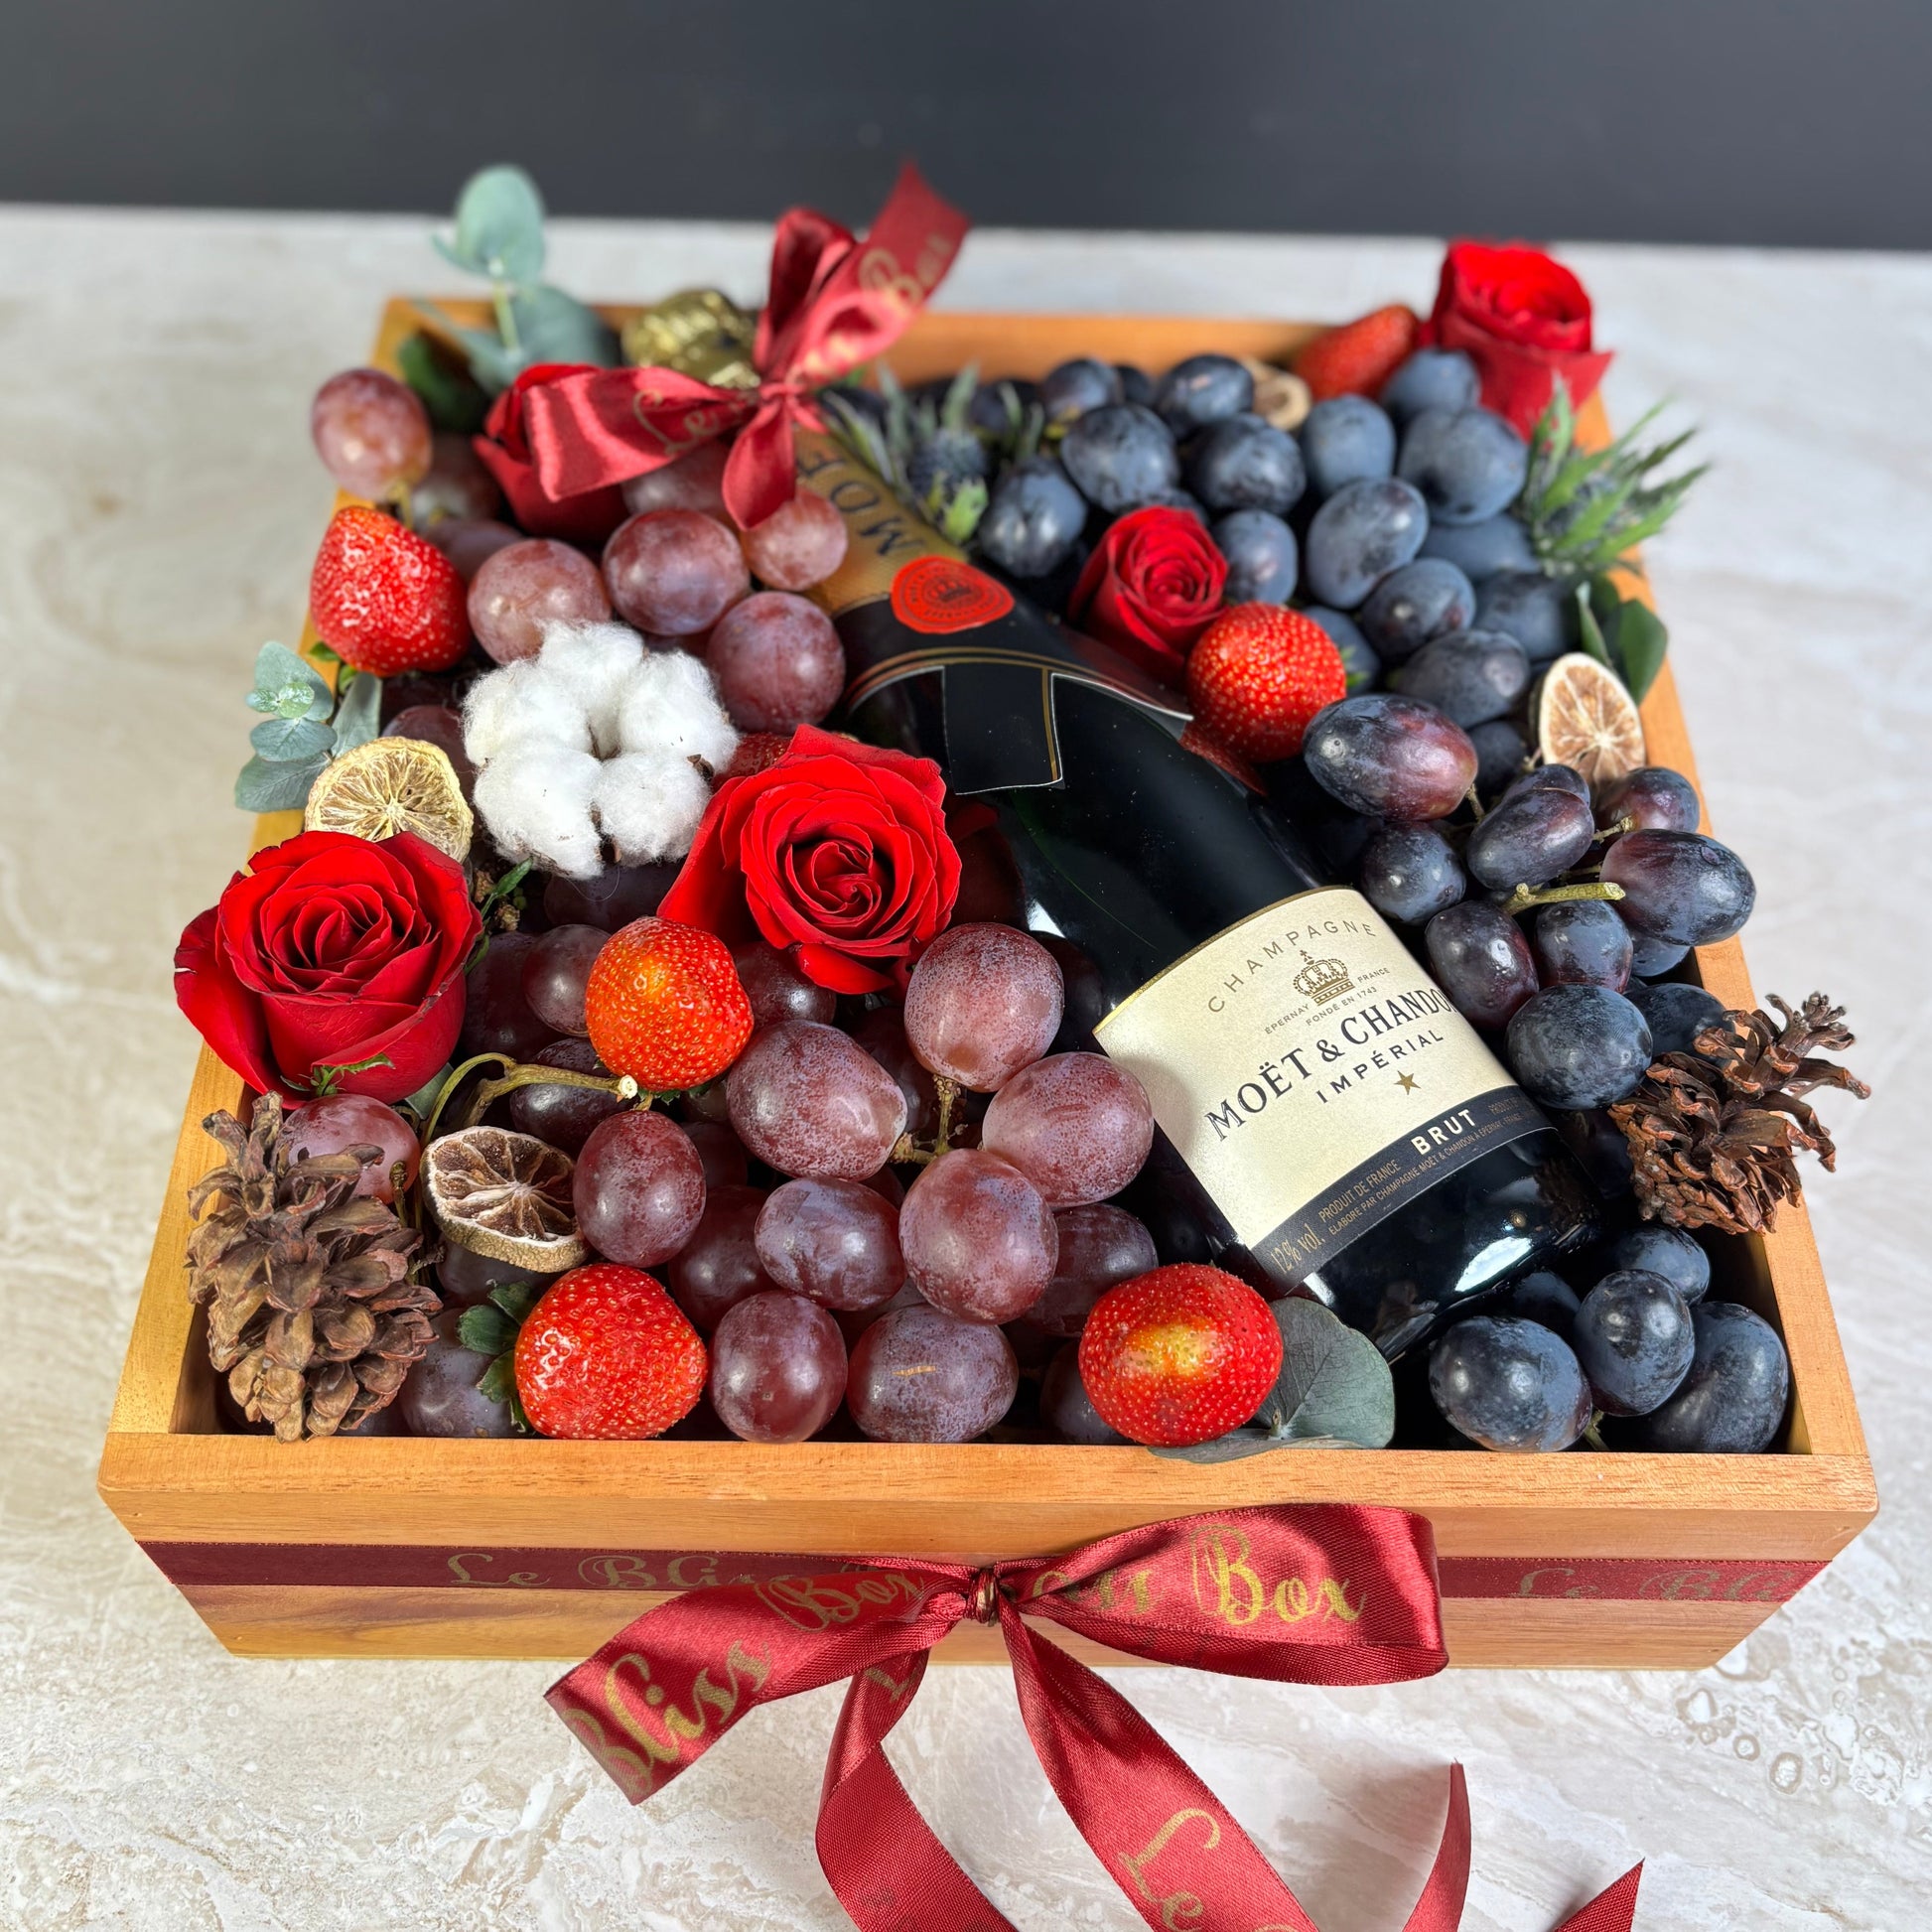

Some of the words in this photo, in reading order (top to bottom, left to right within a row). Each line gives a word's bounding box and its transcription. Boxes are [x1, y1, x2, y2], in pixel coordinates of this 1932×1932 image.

[1208, 920, 1376, 1013] CHAMPAGNE
[1264, 1003, 1310, 1035] ÉPERNAY
[1357, 967, 1390, 984] FRANCE
[1306, 1003, 1340, 1026] FONDÉ
[1341, 996, 1355, 1007] EN
[1356, 986, 1378, 999] 1743
[1204, 1047, 1312, 1142] MOËT
[1315, 1038, 1345, 1062] &
[1315, 1030, 1444, 1104] IMPÉRIAL
[1411, 1109, 1475, 1155] BRUT
[1318, 1189, 1356, 1222] PRODUIT
[1353, 1180, 1369, 1197] DE
[1365, 1160, 1401, 1188] FRANCE
[1361, 1197, 1376, 1211] PAR
[1376, 1168, 1421, 1202] CHAMPAGNE
[1438, 1151, 1447, 1161] &
[1270, 1239, 1303, 1275] 12%
[1298, 1223, 1326, 1254] vol.
[447, 1553, 550, 1586] Le
[1191, 1524, 1366, 1626] Box
[1116, 1807, 1221, 1932] Le
